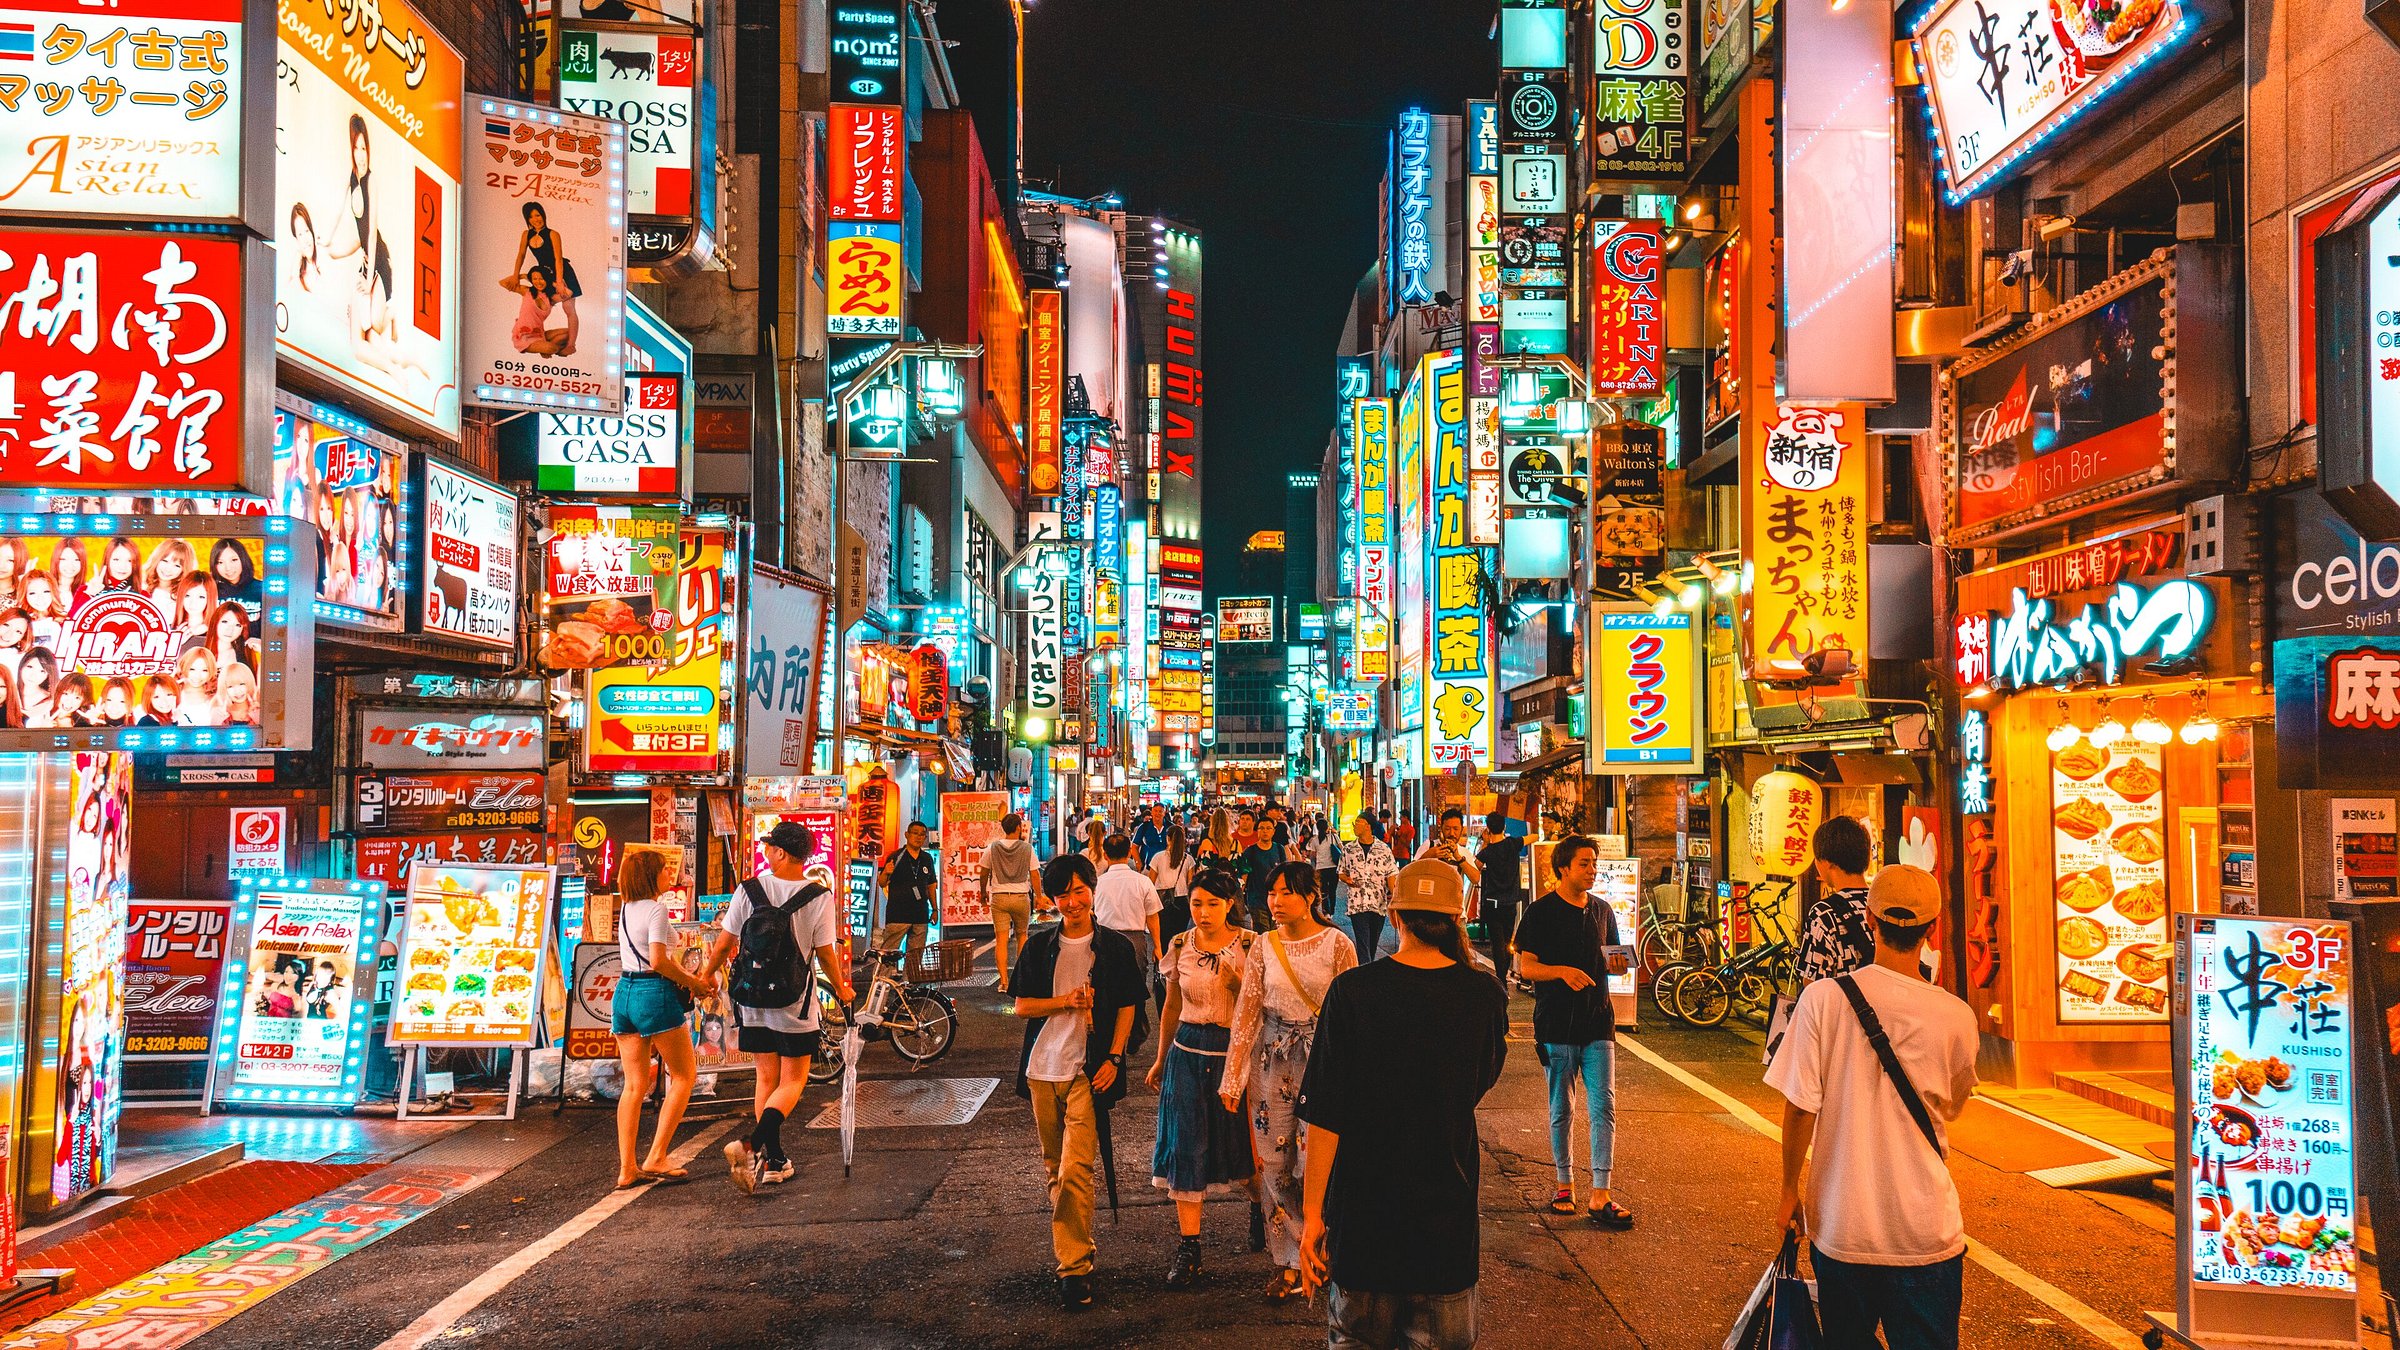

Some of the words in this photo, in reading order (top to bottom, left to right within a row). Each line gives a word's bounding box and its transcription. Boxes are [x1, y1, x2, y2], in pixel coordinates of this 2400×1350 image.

[839, 11, 864, 23] Party
[865, 13, 894, 25] Space
[43, 24, 228, 75] タイ古式
[570, 41, 588, 61] 肉
[1666, 13, 1681, 69] ゴッド
[659, 50, 691, 63] イタリ
[862, 56, 882, 67] SINCE
[882, 57, 899, 68] 2007
[565, 61, 594, 75] バル
[664, 62, 686, 74] アン
[1524, 72, 1545, 82] 6F
[341, 41, 424, 138] Massage
[859, 82, 874, 93] 3F
[0, 75, 228, 121] マッサージ
[1597, 78, 1685, 123] 麻雀
[2017, 80, 2056, 117] KUSHISO
[513, 123, 602, 158] タイ古式
[881, 112, 894, 174] レンタルルーム
[1478, 107, 1498, 170] JAビル
[1513, 130, 1556, 139] グルニエキッチン
[1636, 127, 1682, 159] 4F
[75, 136, 220, 156] アジアンリラックス
[1524, 144, 1546, 154] 5F
[1958, 131, 1980, 170] 3F
[485, 141, 602, 178] マッサージ
[854, 112, 874, 217] リフレッシュ
[75, 175, 201, 200] Relax
[486, 172, 517, 190] 2F
[544, 190, 593, 206] Relax
[881, 178, 894, 214] ホステル
[1401, 107, 1431, 302] カラオケの鉄人
[833, 205, 846, 216] 2F
[854, 224, 877, 237] 1F
[1524, 217, 1545, 227] 4F
[1597, 223, 1616, 236] 3F
[1480, 254, 1497, 319] ビックワン
[1524, 290, 1546, 300] 3F
[0, 241, 227, 366] 湖南
[1604, 233, 1658, 382] CARINA
[831, 317, 898, 332] 博多天神
[1600, 285, 1611, 379] 個室ダイニング
[1611, 285, 1631, 380] カリーナ
[494, 359, 526, 373] 60分
[831, 357, 858, 377] Party
[859, 342, 892, 366] Space
[483, 372, 602, 396] 03-3207-5527
[642, 384, 674, 397] イタリ
[1038, 312, 1052, 452] 個室ダイニング居酒屋
[1480, 385, 1497, 394] 2F
[646, 397, 670, 408] アン
[29, 370, 223, 479] 菜館
[548, 414, 666, 437] XROSS
[869, 424, 886, 435] B1
[1969, 385, 2038, 455] Real
[1526, 436, 1546, 446] 1F
[1606, 442, 1629, 454] BBQ
[1632, 442, 1652, 453] 東京
[563, 440, 654, 463] CASA
[1482, 454, 1495, 464] 1F
[327, 443, 375, 487] 即デート
[1604, 457, 1655, 471] Walton's
[1063, 445, 1081, 523] ホテルがライバル
[1364, 408, 1384, 541] まんが喫茶
[1518, 474, 1531, 484] The
[430, 474, 484, 507] ヘルシー
[429, 499, 470, 538] 肉バル
[554, 518, 675, 539] 肉祭り開催中
[1100, 487, 1117, 554] カラオケ
[1839, 496, 1857, 566] 博多もつ鍋
[437, 537, 475, 556] ヘルシーステーキ
[488, 542, 512, 569] 低糖質
[439, 549, 473, 567] ローストビーフ
[1099, 555, 1116, 567] 747
[1819, 498, 1838, 617] 九州のうまかもん
[2027, 533, 2174, 599] 旭川味噌ラーメン
[487, 566, 511, 593] 低脂肪
[1367, 550, 1383, 616] マンボー
[1618, 572, 1644, 589] 2F
[1767, 494, 1817, 662] まっちゃん
[470, 587, 510, 614] 高タンパク
[1106, 582, 1118, 614] 麻雀
[1840, 569, 1859, 619] 水炊き
[82, 600, 140, 630] community
[469, 612, 510, 638] 低カロリー
[1605, 613, 1687, 627] オンラインカフェ
[2346, 610, 2391, 630] Stylish
[55, 617, 183, 672] KIRARI
[85, 661, 176, 676] 出会いカフェ
[1363, 652, 1386, 665] 24h
[1628, 633, 1669, 745] クラウン
[1165, 697, 1186, 708] ゲーム
[1332, 697, 1357, 711] 完全
[1343, 710, 1368, 722] 個室
[633, 734, 706, 750] 受付3F
[445, 750, 464, 759] Style
[466, 750, 487, 759] Space
[1433, 745, 1486, 760] マンボー
[1639, 749, 1658, 761] B1
[1962, 709, 1988, 815] 角煮
[182, 771, 215, 782] XROSS
[230, 771, 256, 782] CASA
[389, 788, 466, 806] レンタルルーム
[469, 778, 542, 811] Eden
[459, 812, 540, 826] 03-3203-9666
[952, 809, 998, 822] 飲み放題
[2343, 809, 2385, 821] 第3NKビル
[1781, 788, 1812, 866] 鉄なべ餃子
[236, 843, 278, 853] 防犯カメラ
[236, 856, 277, 868] すてるな
[364, 862, 388, 876] 4F
[333, 906, 360, 915] Massage
[258, 914, 309, 937] Asian
[312, 923, 356, 939] Relax
[142, 935, 219, 959] ルーム
[256, 938, 299, 952] Welcome
[299, 941, 344, 955] Foreigner
[2287, 930, 2339, 969] 3F
[2197, 941, 2212, 990] 三十年
[124, 975, 214, 1013] Eden
[2218, 931, 2341, 1049] 串荘
[127, 1037, 208, 1052] 03-3203-9666
[2282, 1044, 2342, 1058] KUSHISO
[2197, 994, 2212, 1146] 継ぎ足された秘伝のタレ
[2311, 1073, 2339, 1087] 個室
[2311, 1088, 2339, 1101] 完備
[2258, 1137, 2297, 1152] 串焼き
[2258, 1157, 2312, 1176] 串揚げ
[2202, 1264, 2344, 1286] Tel:03-6233-7975
